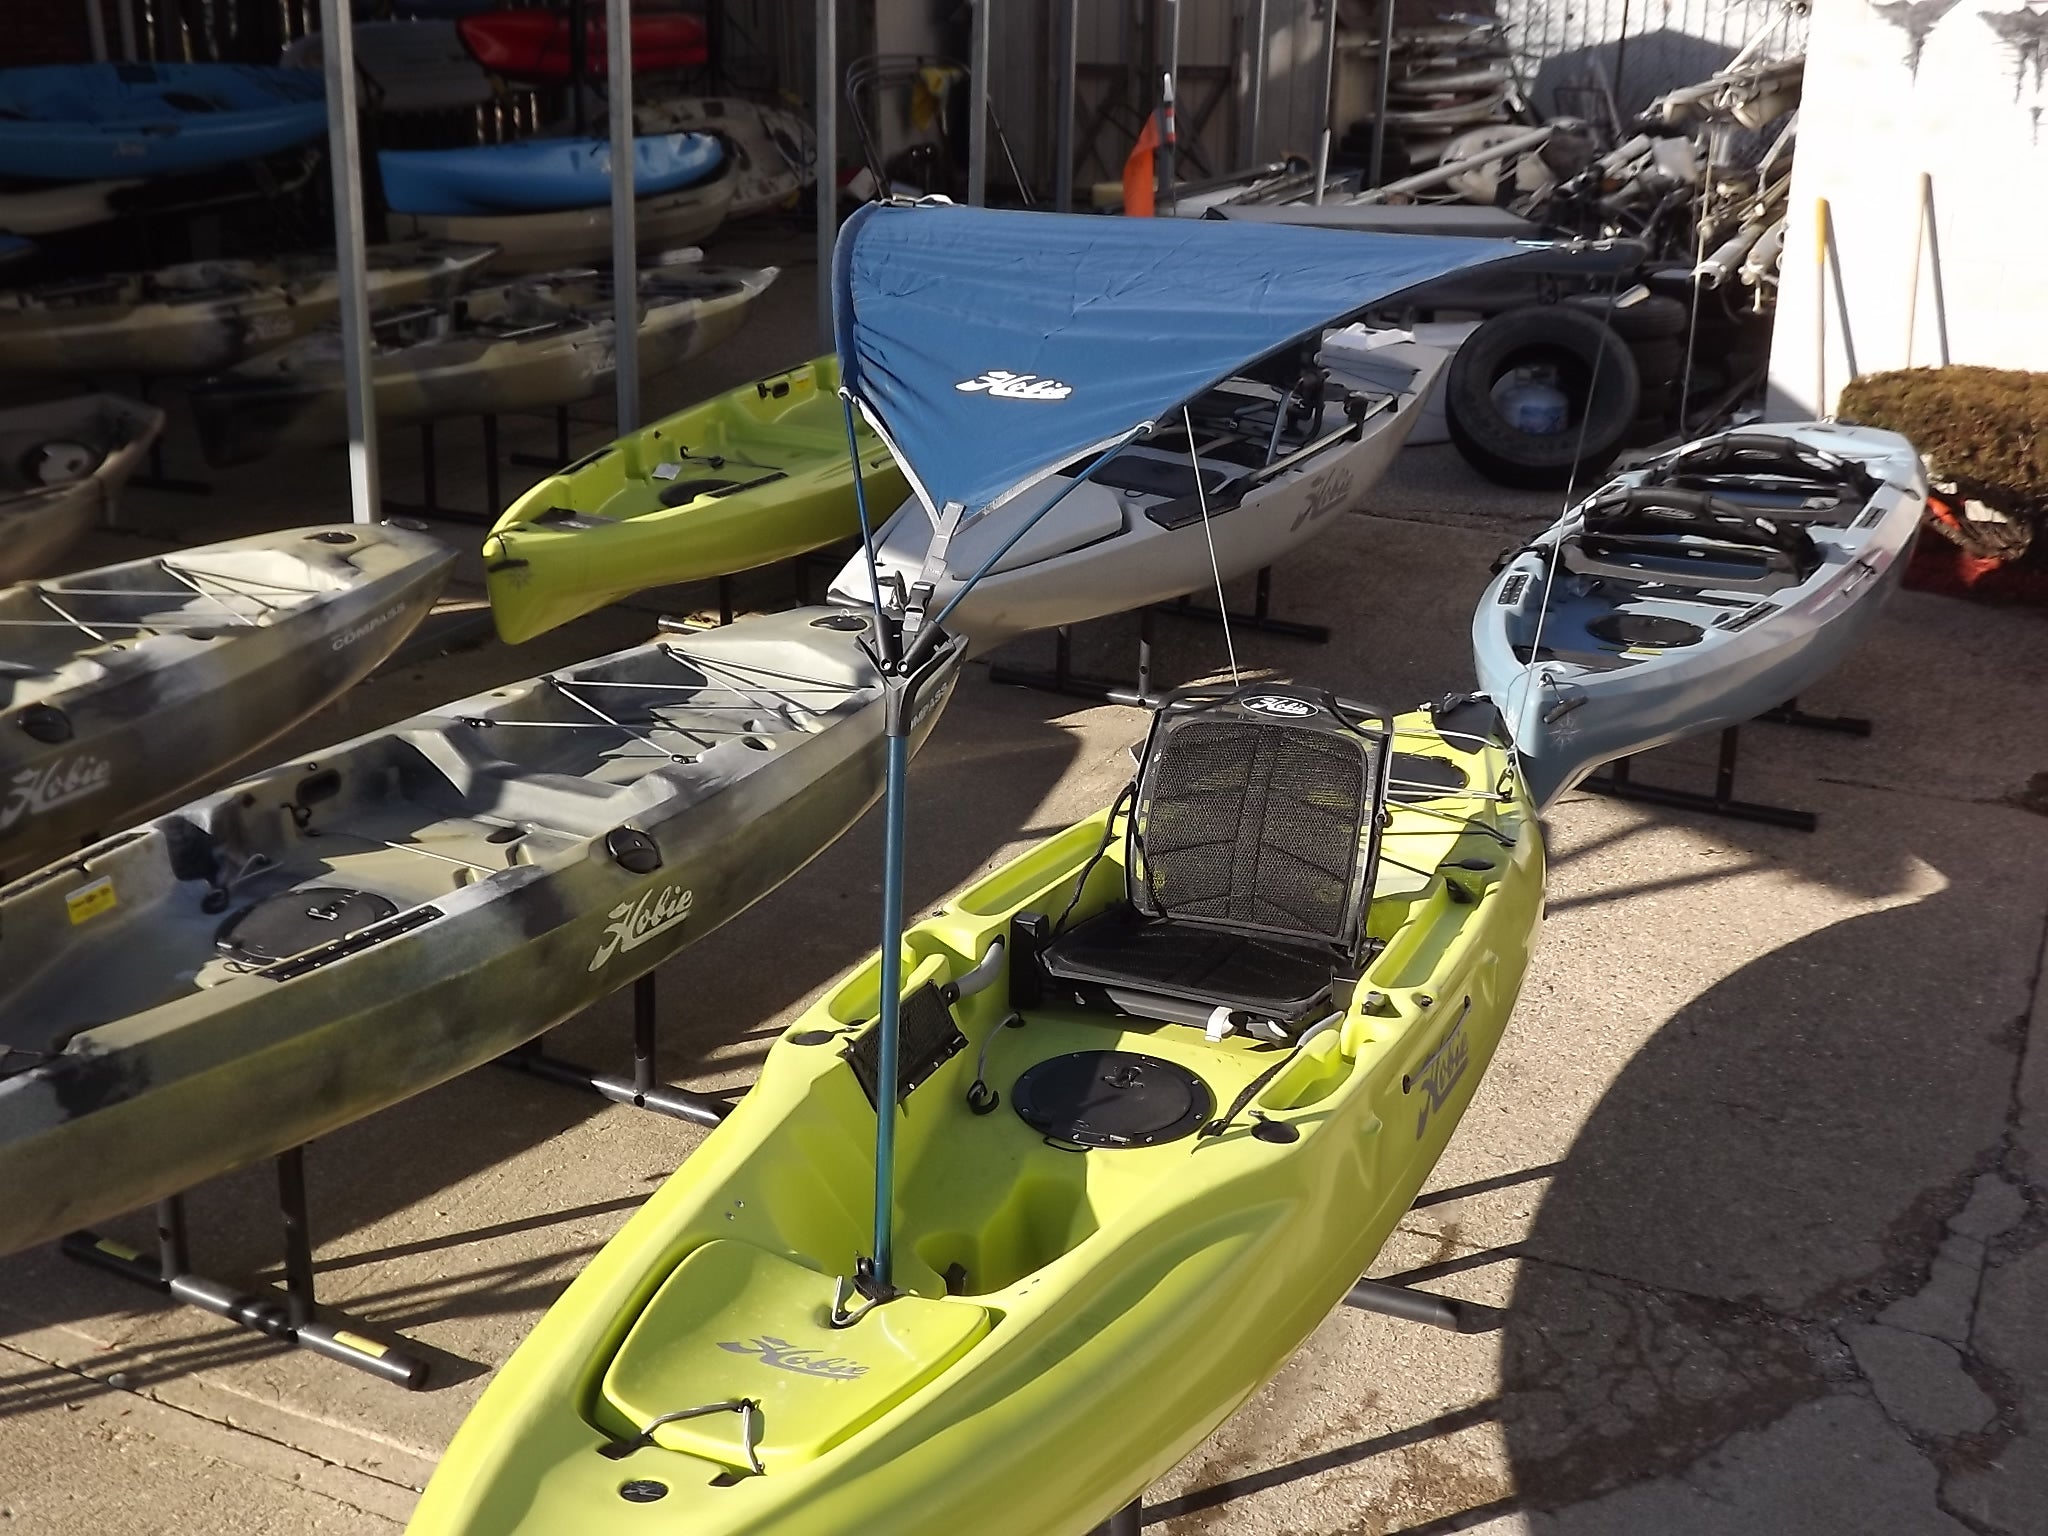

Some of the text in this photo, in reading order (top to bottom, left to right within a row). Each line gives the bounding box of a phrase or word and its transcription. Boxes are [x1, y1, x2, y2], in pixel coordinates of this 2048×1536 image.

[954, 370, 1073, 400] Hobie
[1289, 466, 1354, 533] Hobie
[331, 601, 406, 651] COMPASS
[911, 682, 948, 732] MPASS
[1249, 697, 1309, 715] Hobie
[0, 755, 110, 831] Hobie
[587, 886, 693, 972] Hobie
[716, 1335, 870, 1380] Hobie
